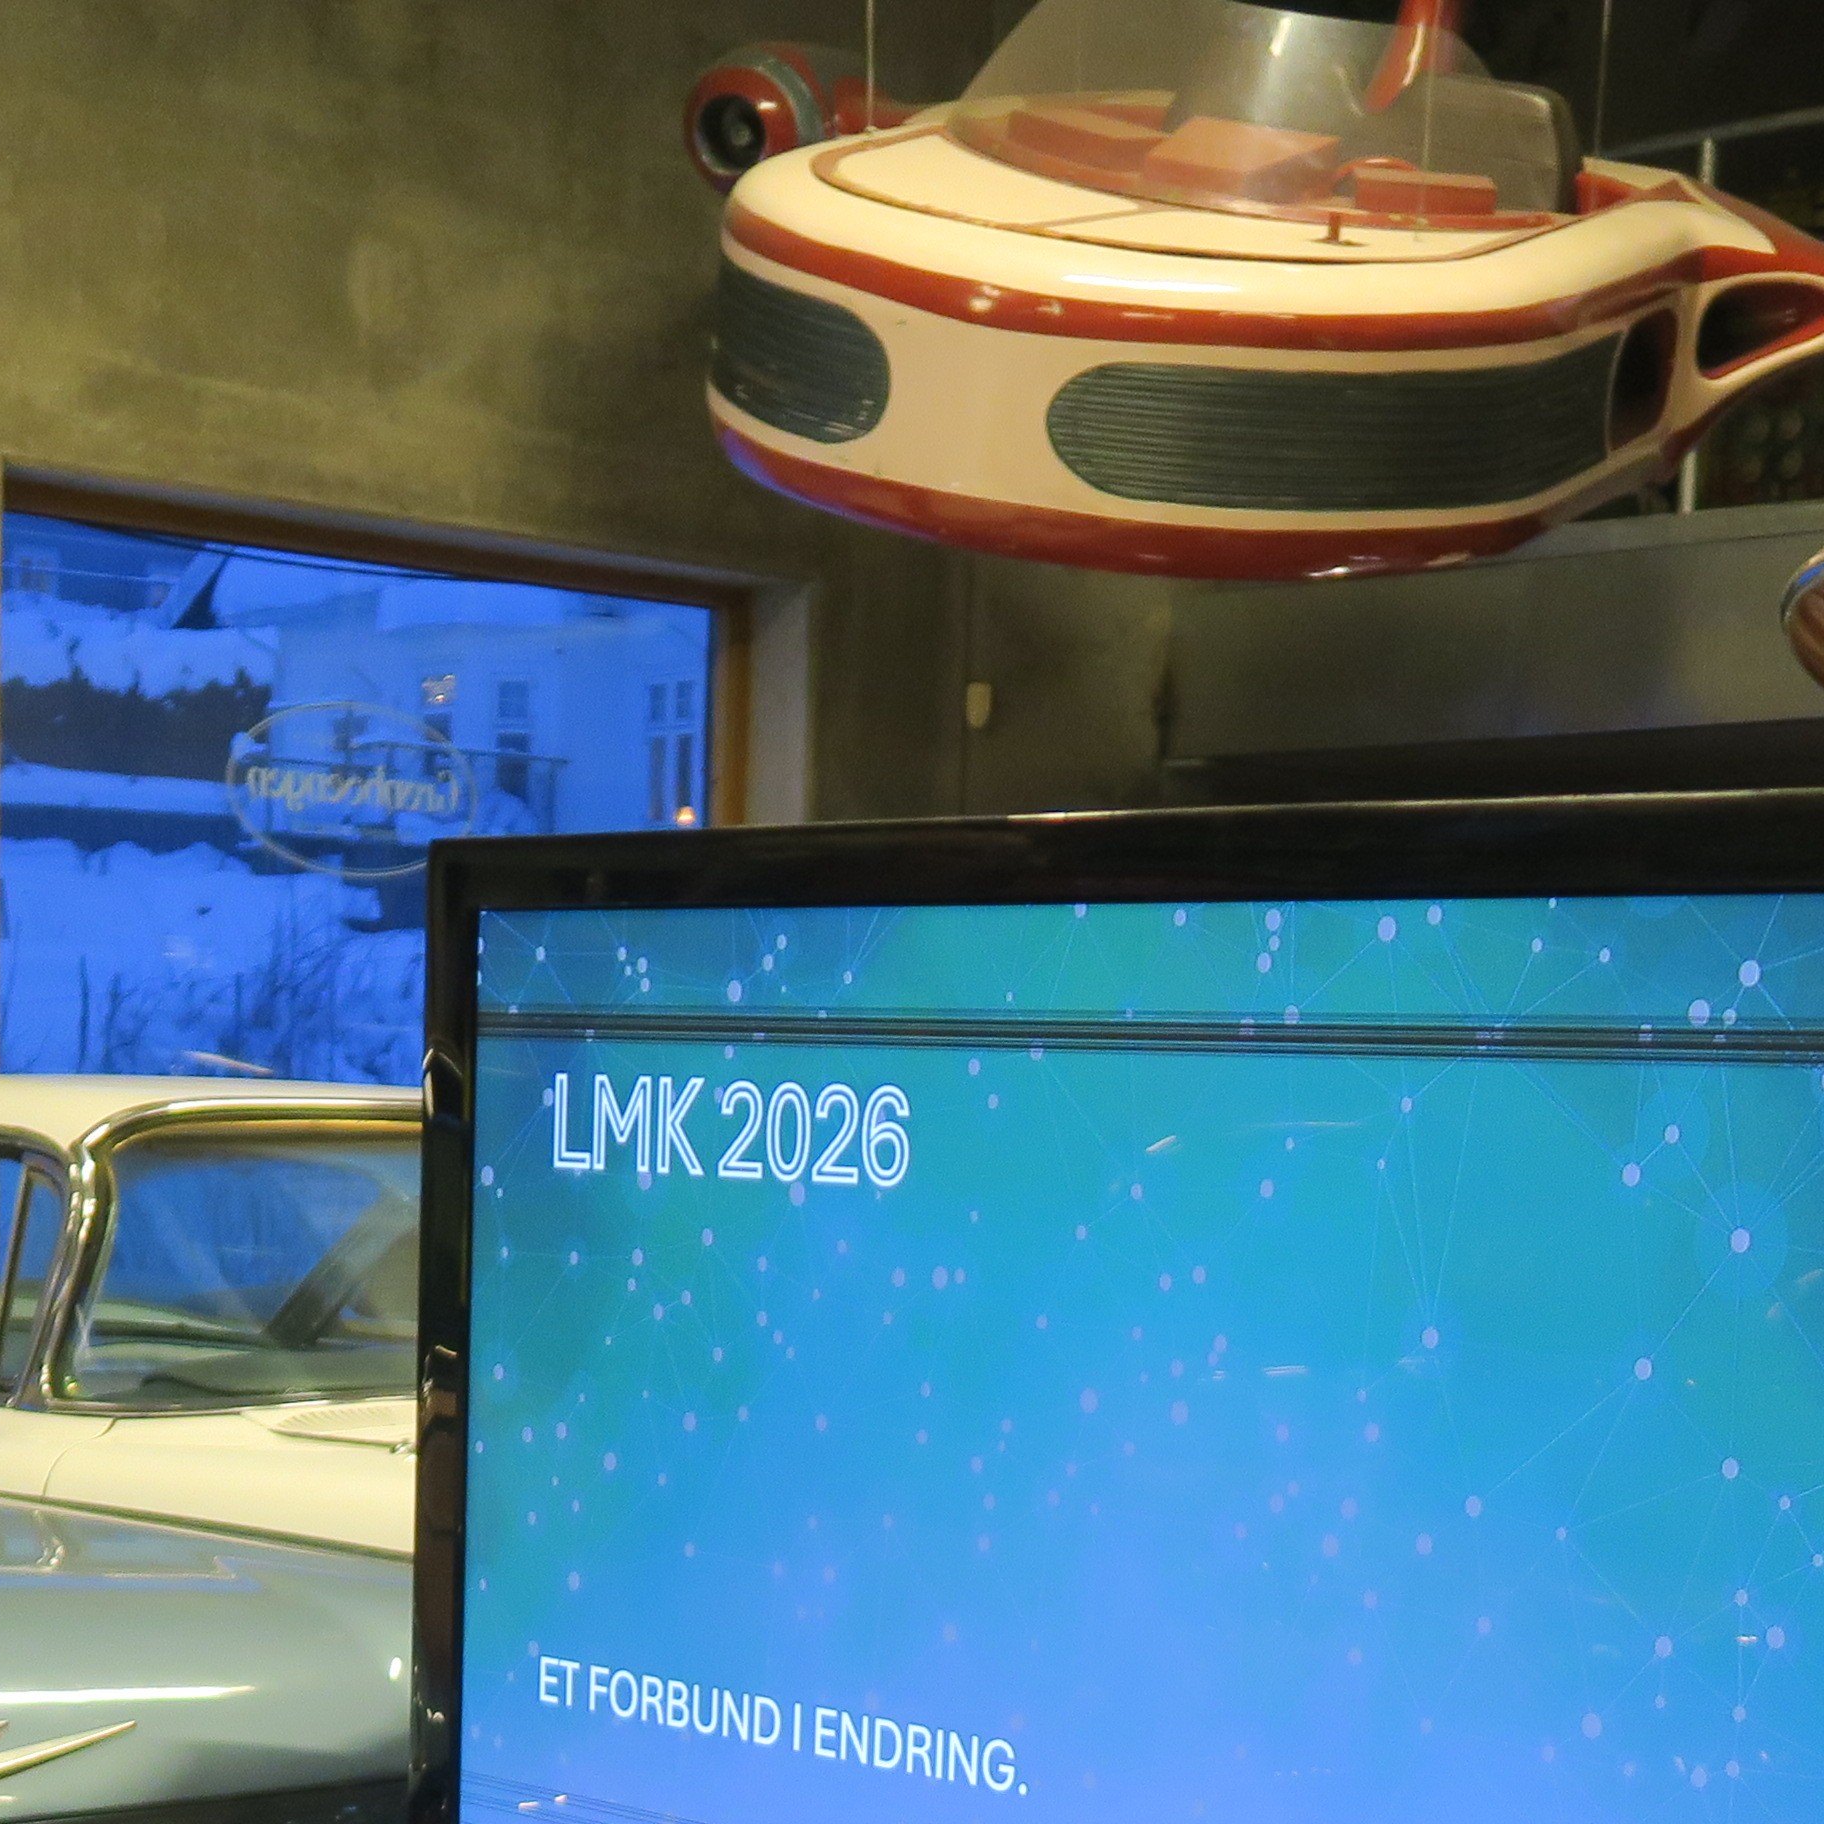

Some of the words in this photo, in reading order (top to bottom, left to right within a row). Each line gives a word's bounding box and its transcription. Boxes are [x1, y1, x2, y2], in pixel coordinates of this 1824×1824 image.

[552, 1072, 706, 1177] LMK
[717, 1079, 911, 1188] 2026
[538, 1655, 581, 1708] ET
[587, 1664, 782, 1747] FORBUND
[791, 1701, 803, 1752] I
[813, 1706, 1030, 1798] ENDRING.
